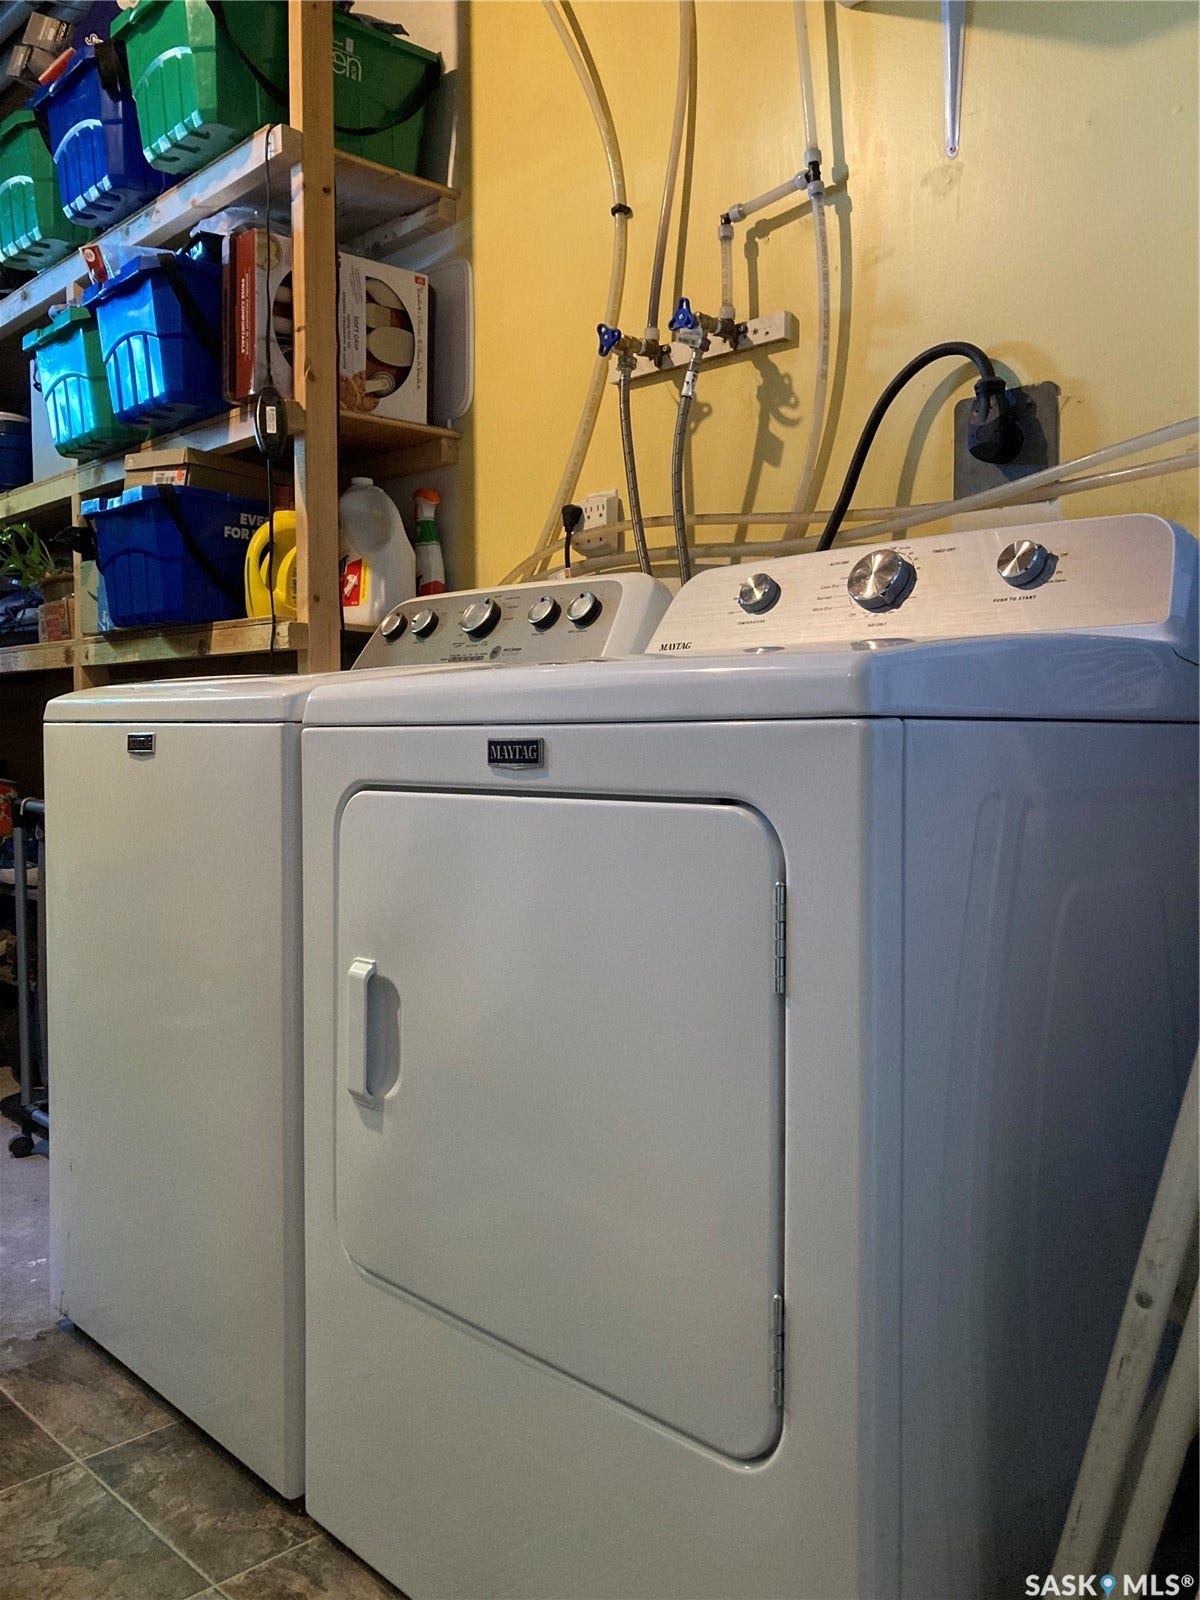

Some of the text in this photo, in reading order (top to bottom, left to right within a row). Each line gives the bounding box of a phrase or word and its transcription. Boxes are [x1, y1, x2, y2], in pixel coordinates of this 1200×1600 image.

[224, 525, 250, 540] FOR
[658, 641, 692, 652] MAYTAG
[489, 745, 538, 760] MAYTAG
